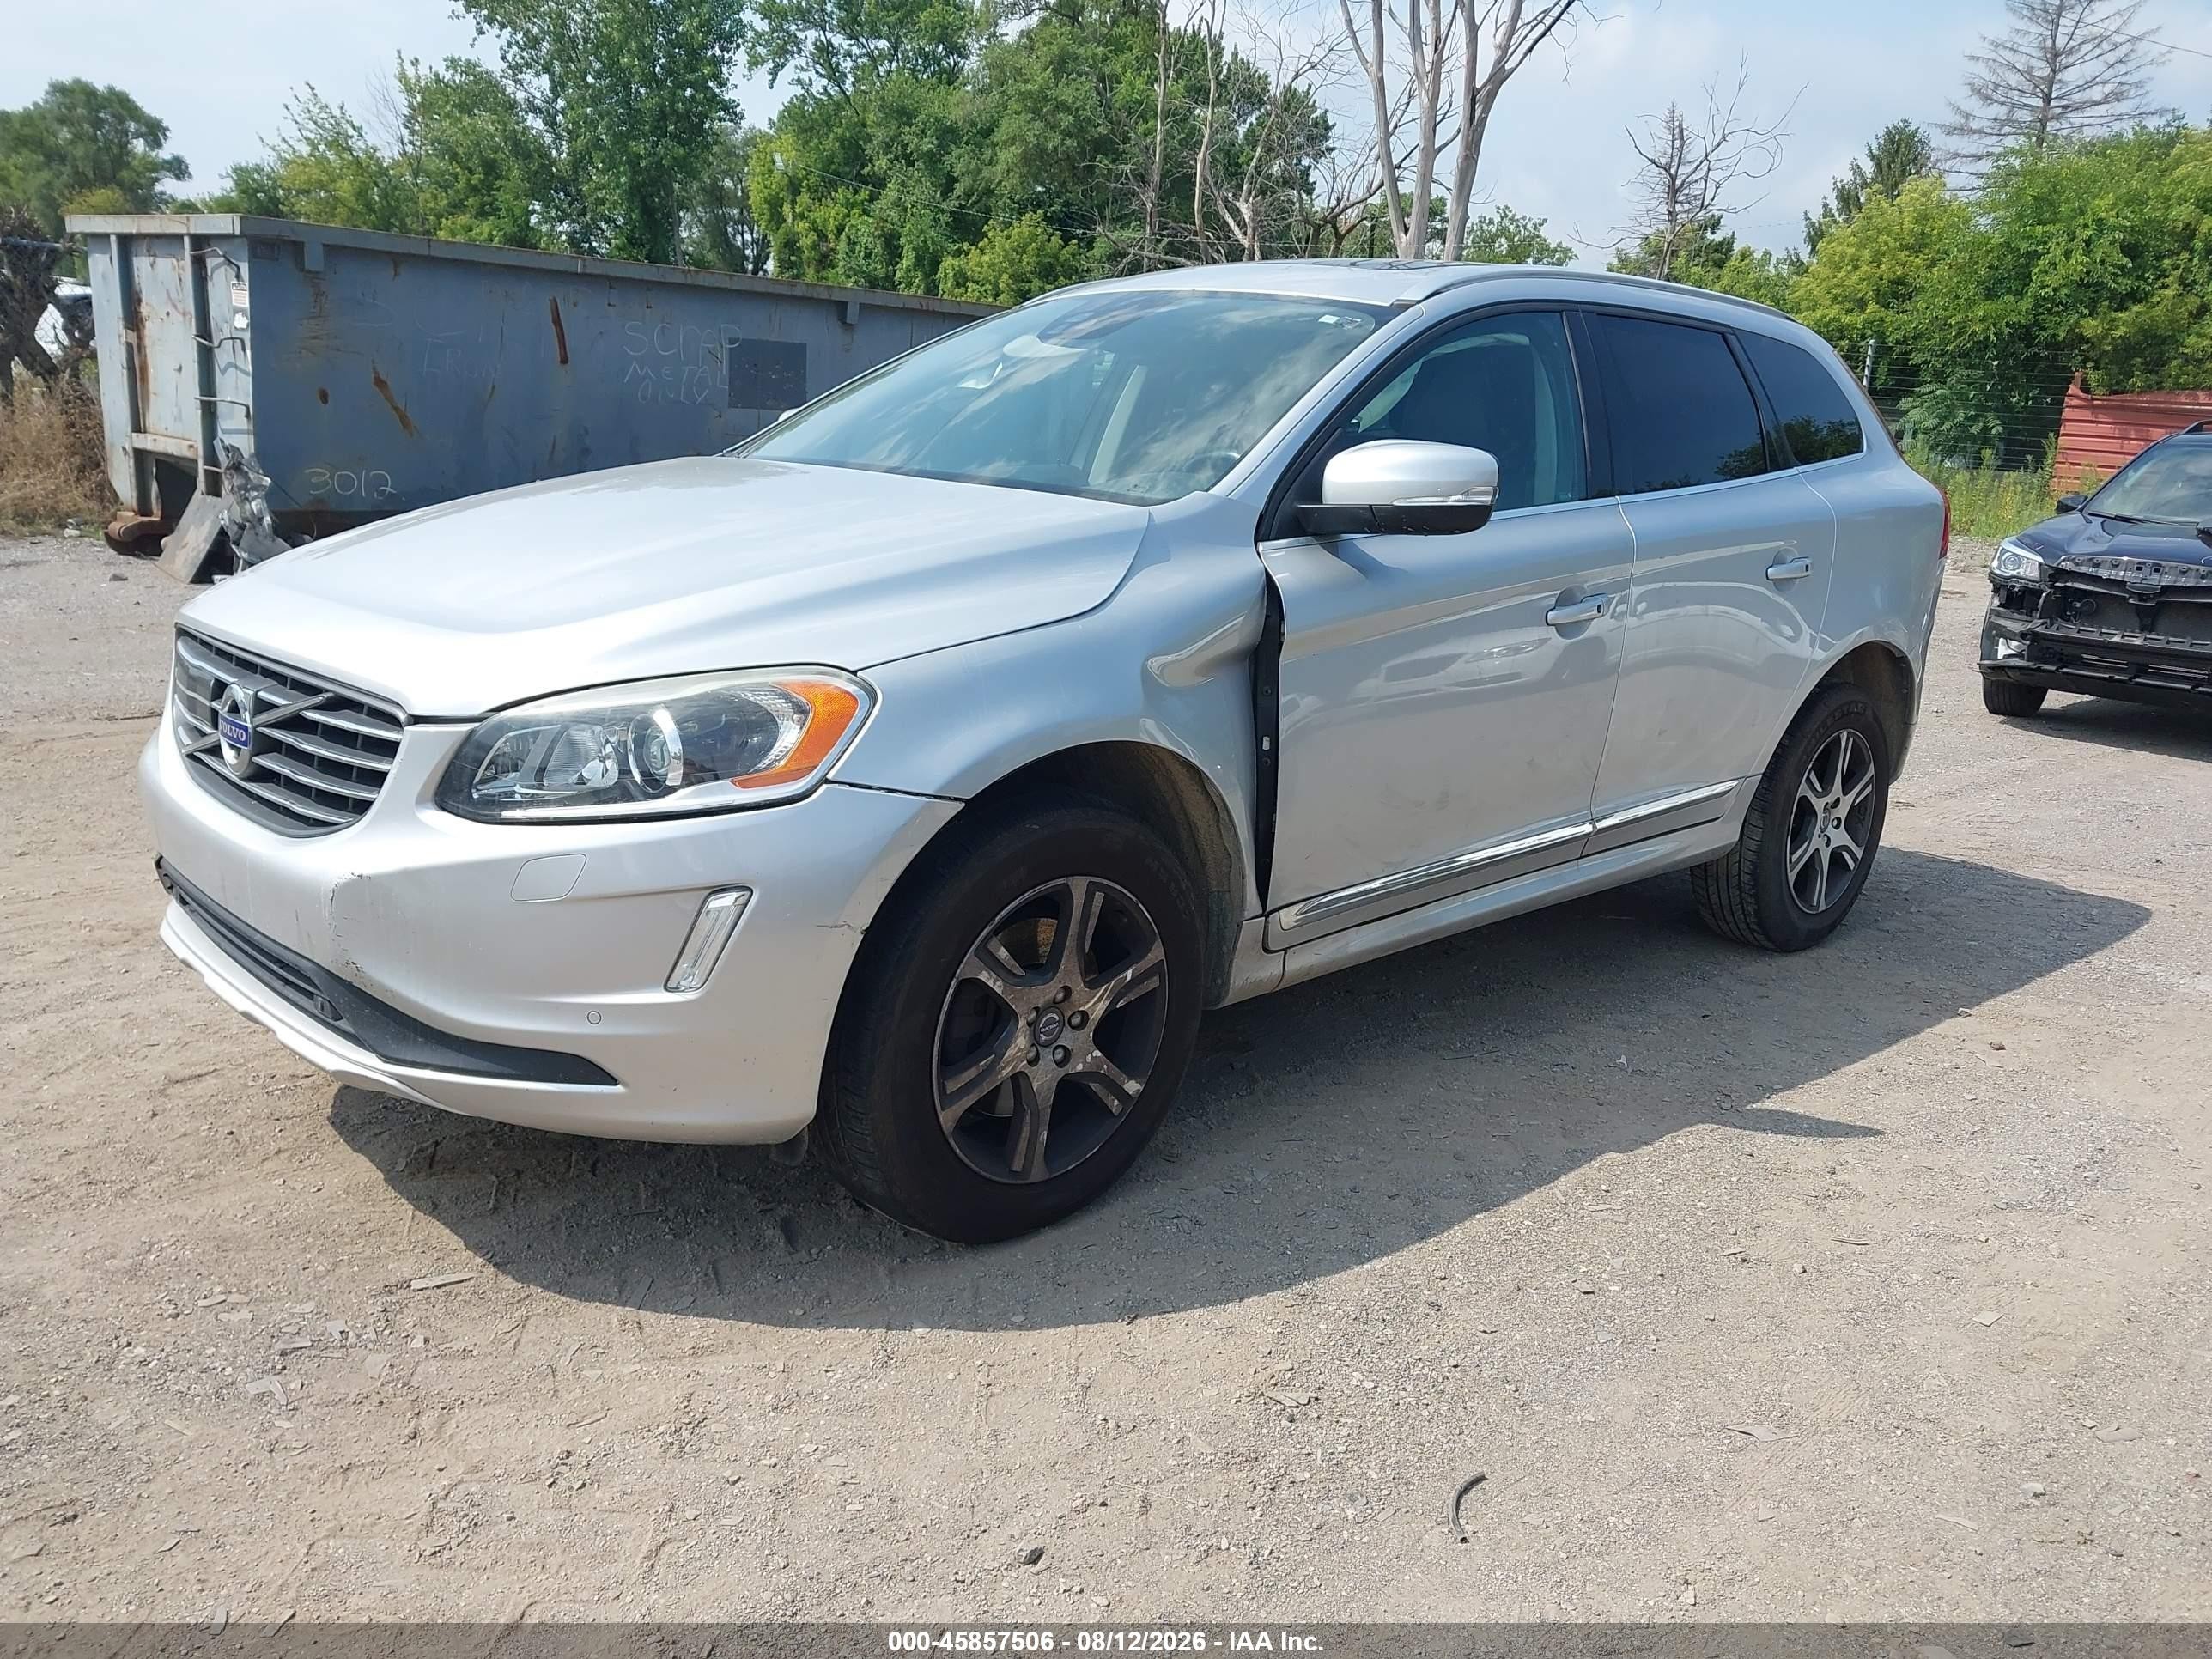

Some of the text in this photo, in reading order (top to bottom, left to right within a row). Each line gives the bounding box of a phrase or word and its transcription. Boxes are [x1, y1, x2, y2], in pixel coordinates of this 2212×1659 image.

[623, 361, 729, 389] METAL
[303, 467, 398, 500] 3012
[219, 720, 246, 743] VOLVO
